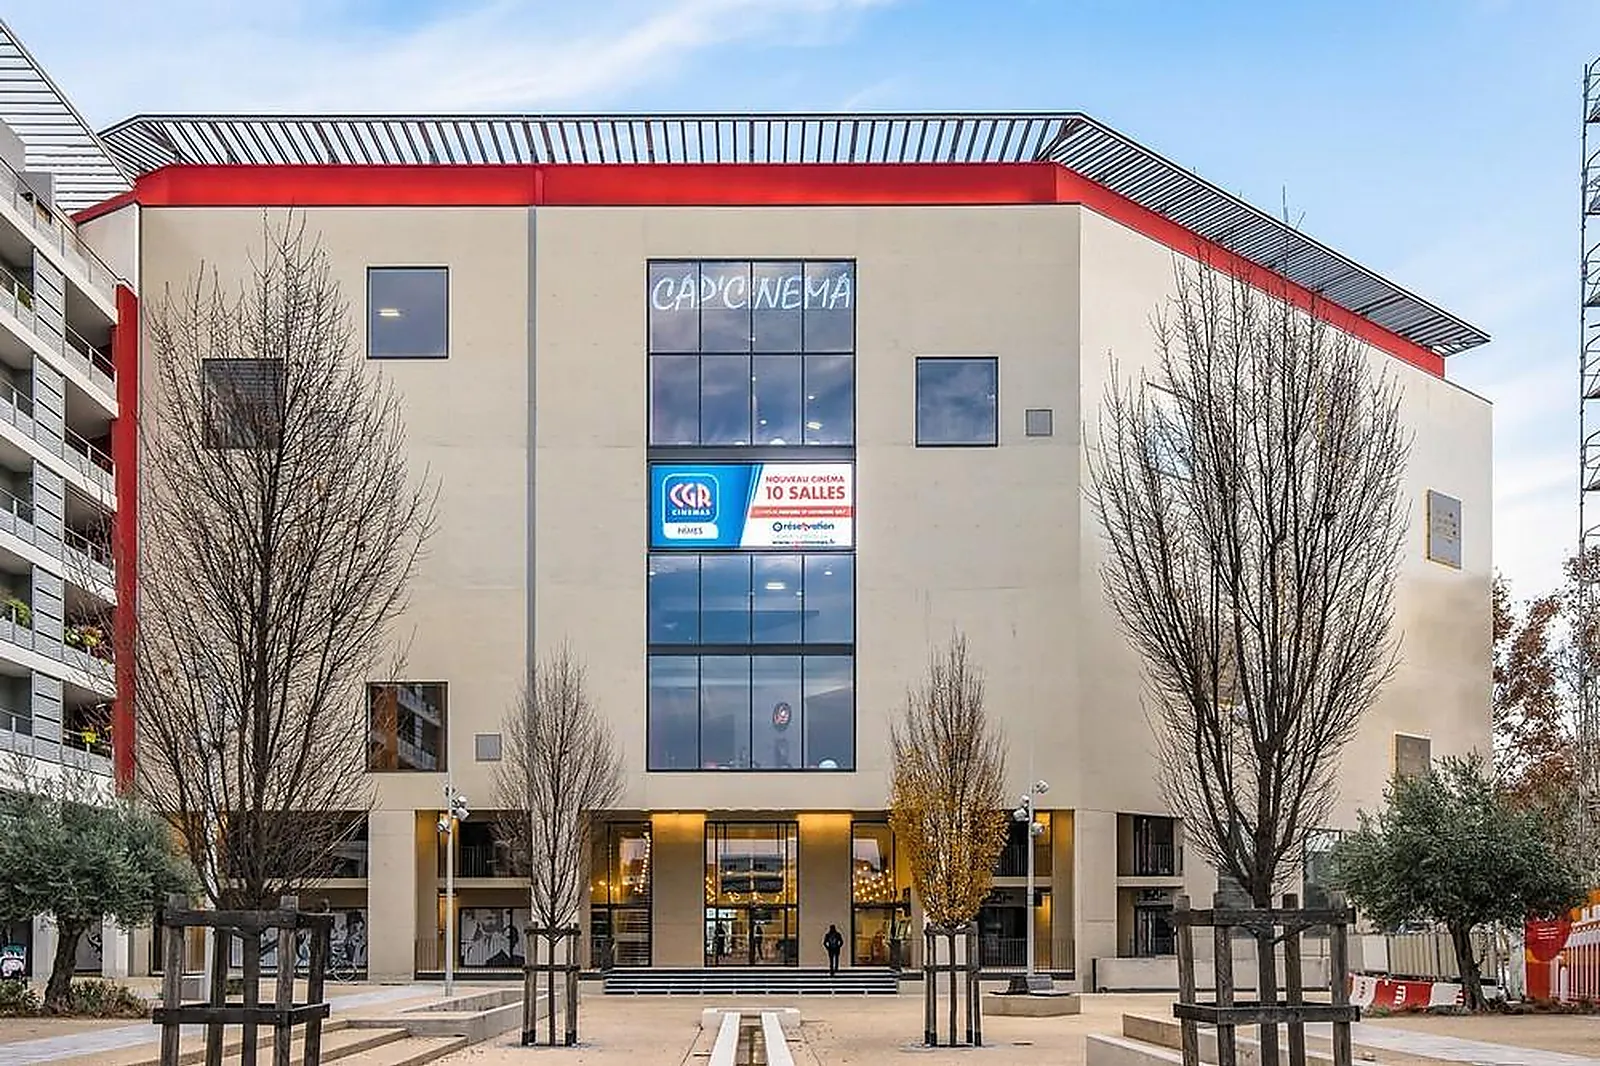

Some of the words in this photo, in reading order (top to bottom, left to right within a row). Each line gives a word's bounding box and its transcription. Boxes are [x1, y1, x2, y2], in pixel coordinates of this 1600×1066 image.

[765, 475, 808, 483] NOUVEAU
[669, 483, 712, 509] CGR
[766, 486, 783, 500] 10
[789, 486, 845, 500] SALLES
